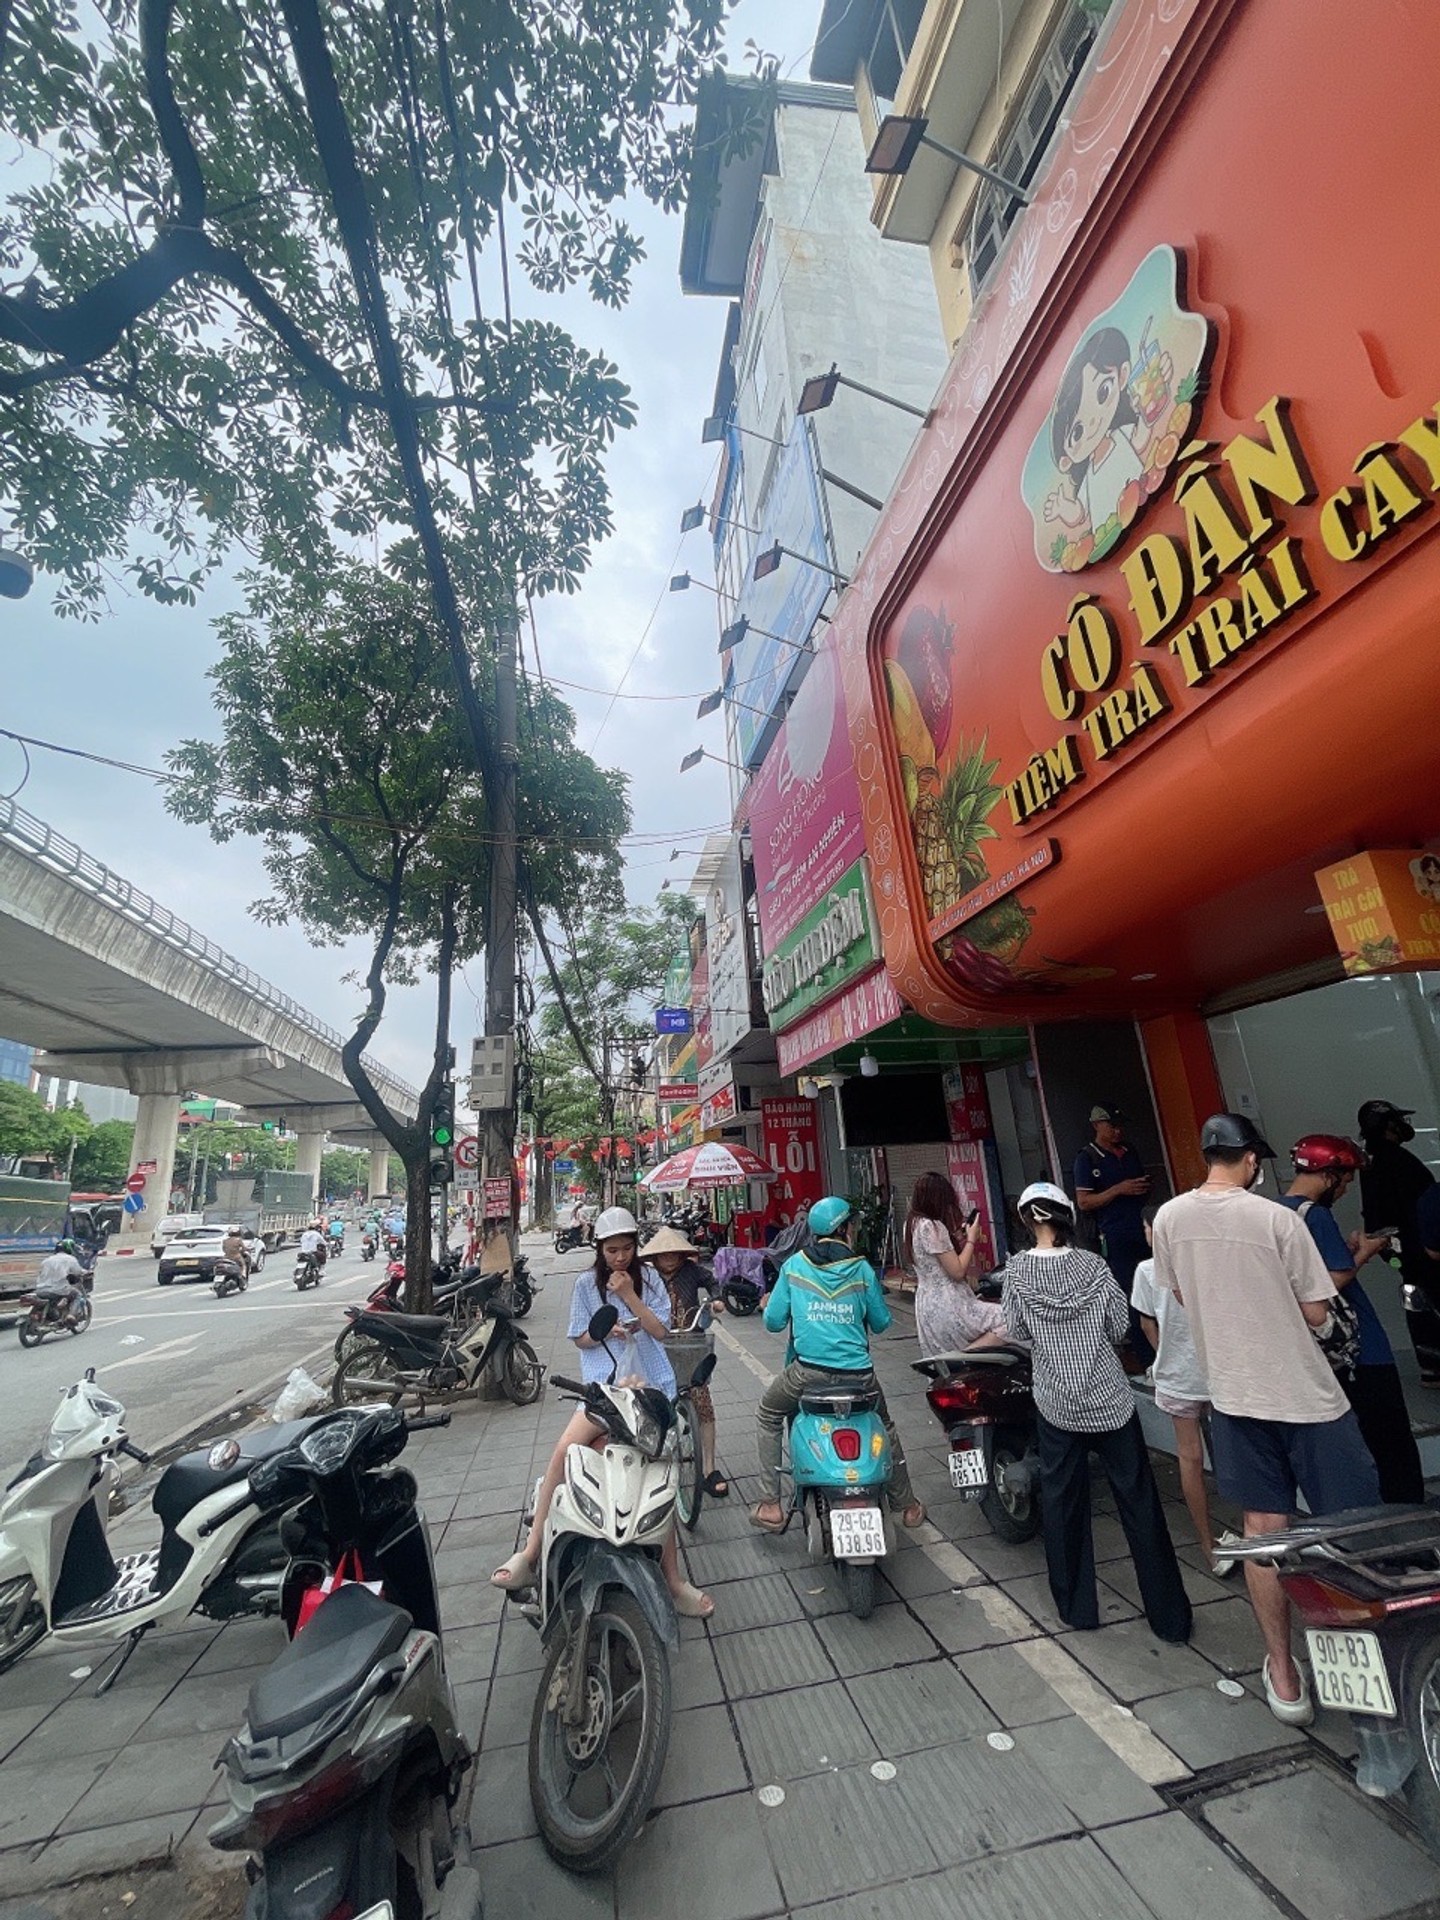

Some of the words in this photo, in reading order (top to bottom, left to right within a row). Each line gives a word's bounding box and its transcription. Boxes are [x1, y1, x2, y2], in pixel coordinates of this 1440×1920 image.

[1041, 592, 1116, 722] CÔ
[1120, 394, 1316, 646] ĐẤN
[1003, 733, 1077, 826] TIỆM
[1081, 660, 1164, 761] TRÀ
[1169, 538, 1310, 686] TRÁI
[1320, 400, 1440, 563] CÂY
[1332, 864, 1360, 890] TRÀ
[1326, 895, 1357, 922] TRÁI
[1358, 886, 1384, 912] CÂY
[765, 1100, 783, 1113] BẢO
[786, 1101, 812, 1113] HÀNH
[768, 1118, 779, 1128] 12
[781, 1116, 812, 1128] THÁNG
[769, 1130, 816, 1173] LỖI
[952, 1450, 979, 1469] 29-C1
[837, 1512, 875, 1532] 29-G2
[836, 1534, 882, 1554] 138.96
[1315, 1633, 1371, 1669] 90-B3
[1317, 1668, 1389, 1710] 286.21
